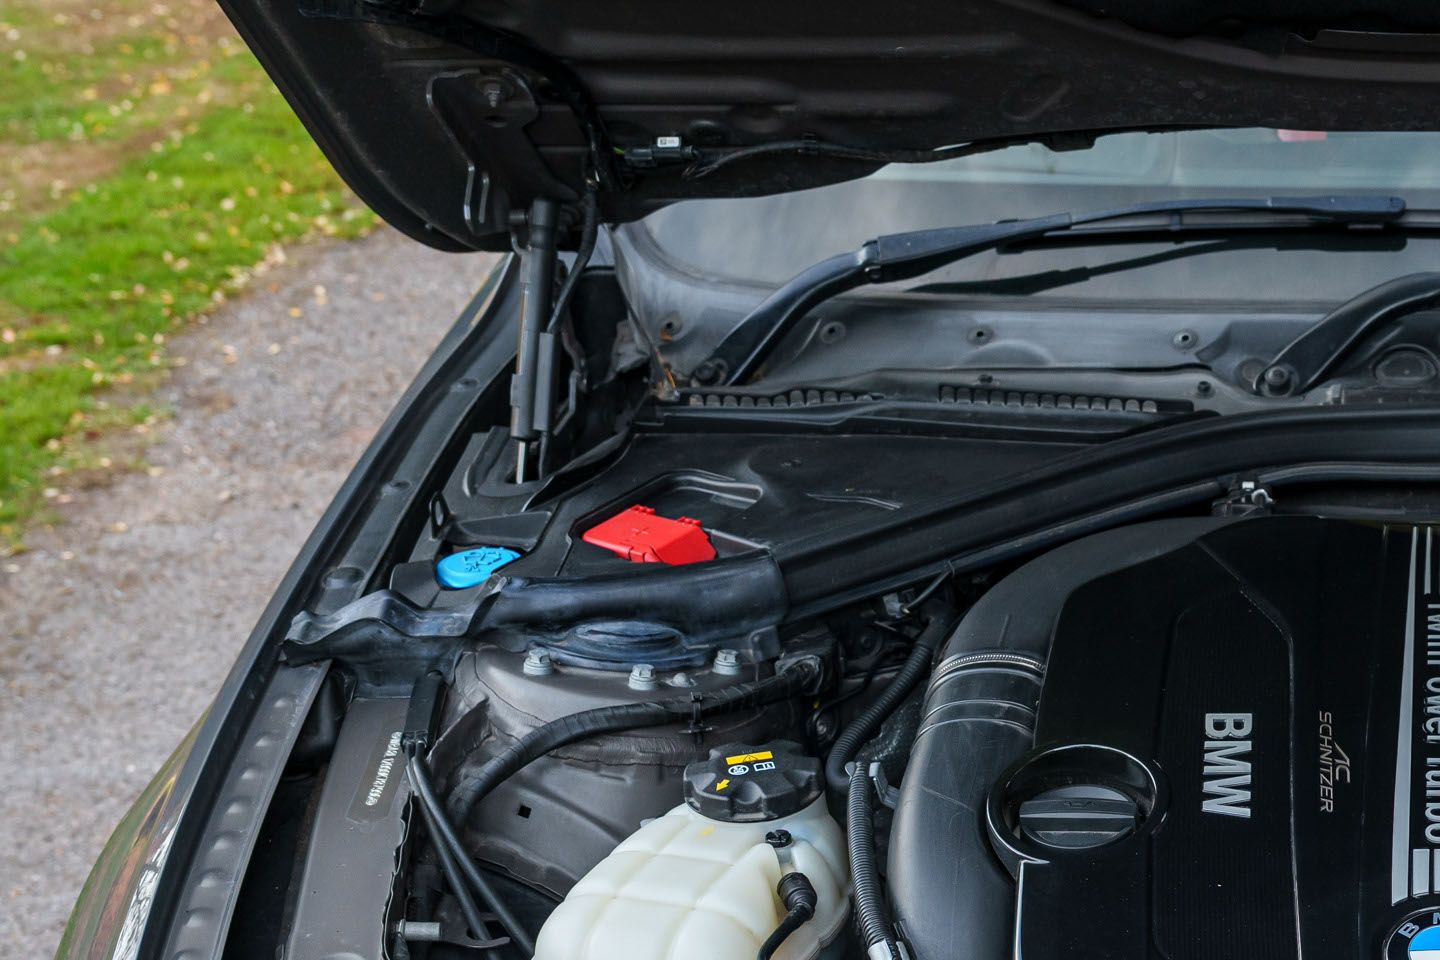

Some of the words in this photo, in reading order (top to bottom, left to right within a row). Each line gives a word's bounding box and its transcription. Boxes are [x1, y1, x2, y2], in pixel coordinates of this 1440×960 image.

[1202, 712, 1253, 818] BMW
[1319, 711, 1334, 813] SCHNITZER
[1334, 741, 1351, 783] AC
